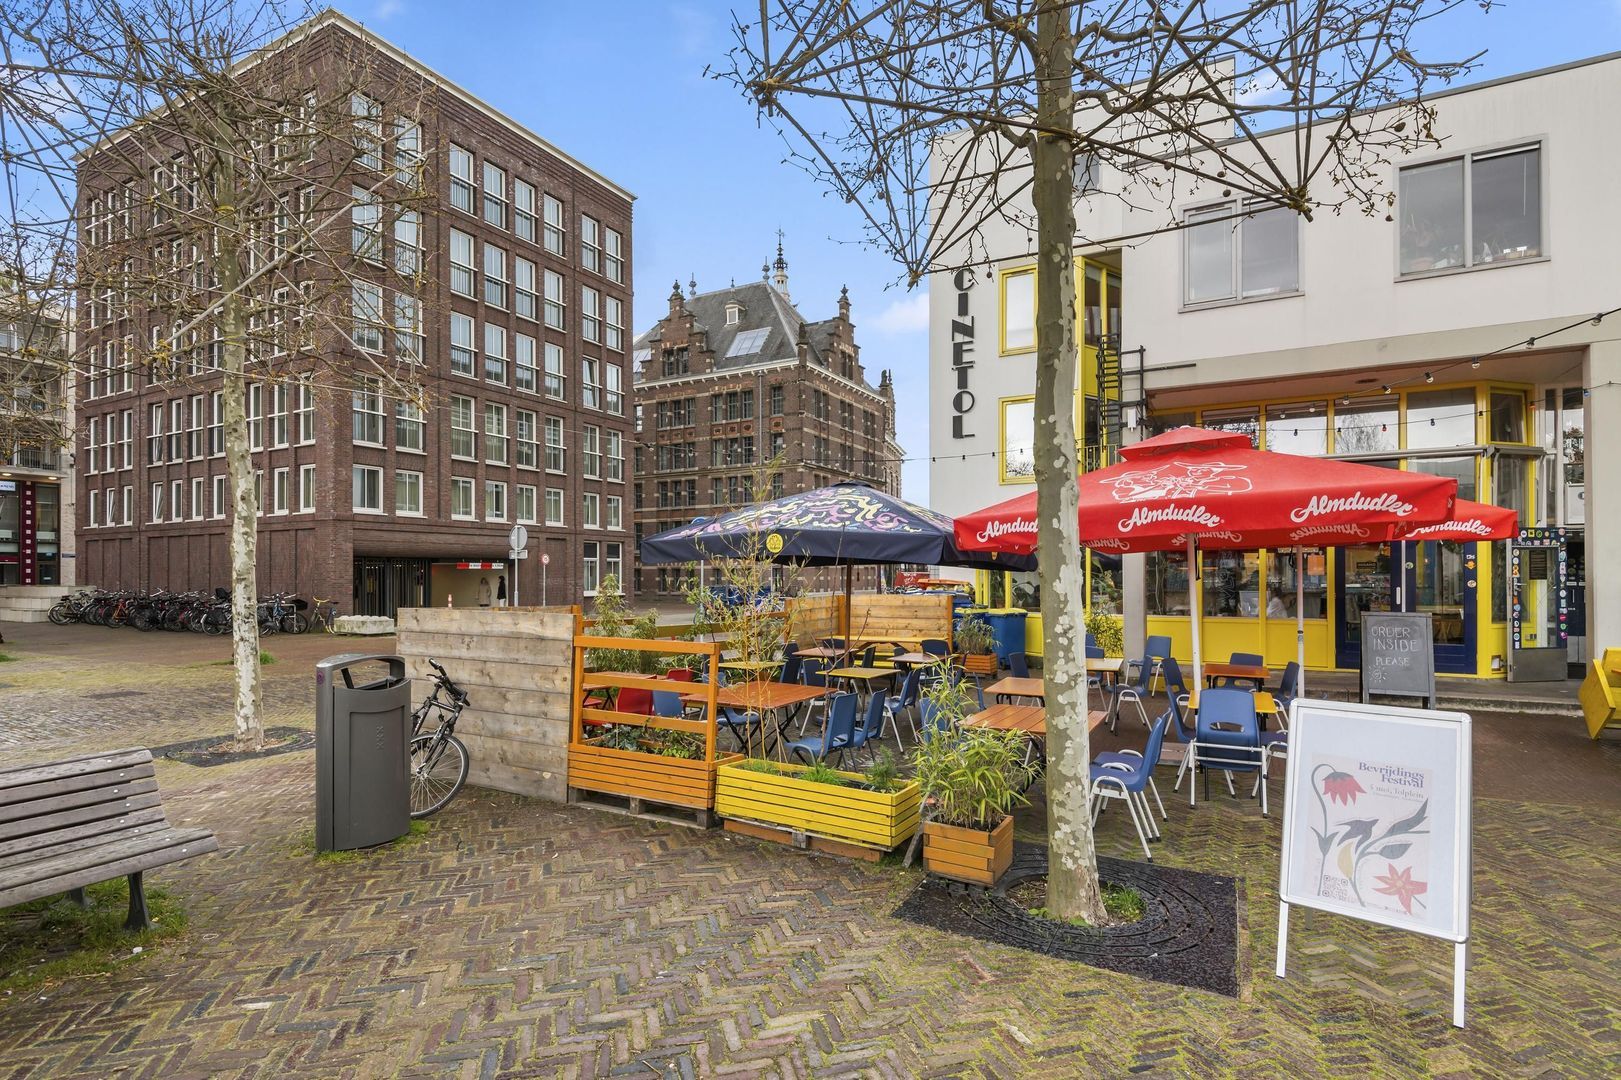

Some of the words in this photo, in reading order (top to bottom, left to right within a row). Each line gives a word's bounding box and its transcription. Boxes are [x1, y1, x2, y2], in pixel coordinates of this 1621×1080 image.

[952, 268, 975, 439] CINETOL
[1290, 491, 1414, 523] Almdudler
[1118, 503, 1221, 533] Almdudler
[977, 517, 1039, 542] Almdud
[1371, 626, 1411, 638] ORDER
[1373, 638, 1419, 653] INSIDE
[1375, 656, 1411, 668] PLEASE
[1359, 762, 1425, 779] Bevrijdings
[1381, 774, 1424, 789] Festival
